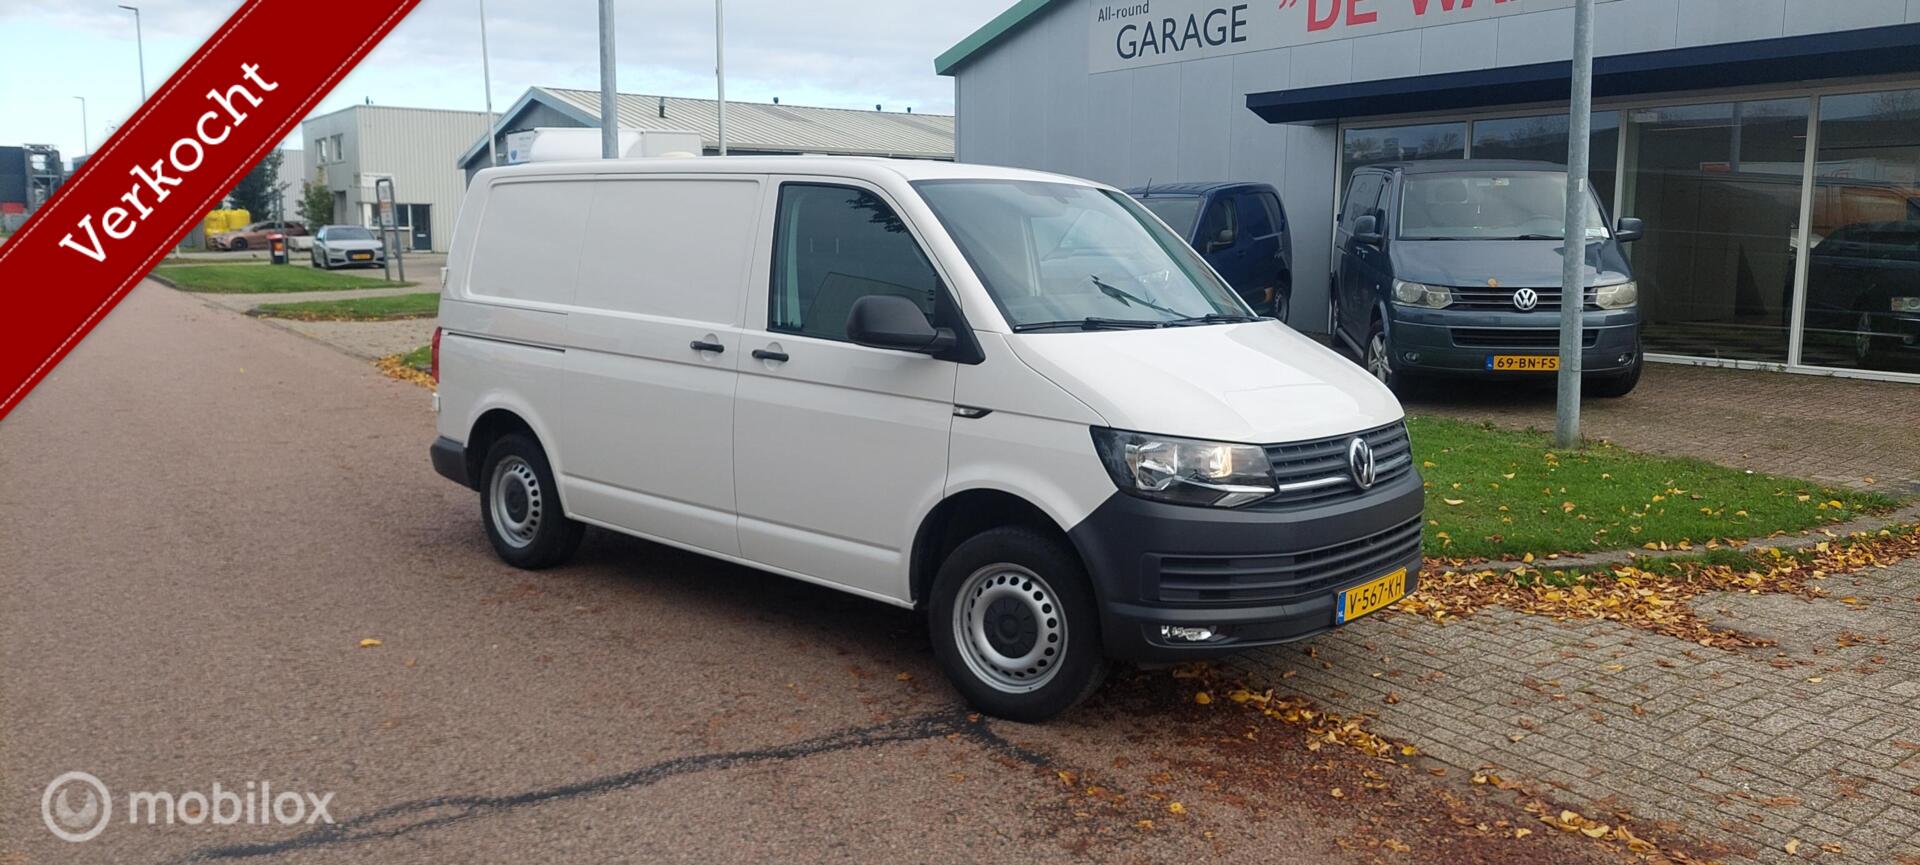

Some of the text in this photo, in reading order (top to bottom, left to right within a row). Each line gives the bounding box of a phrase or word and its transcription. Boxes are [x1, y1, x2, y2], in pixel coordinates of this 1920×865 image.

[1098, 1, 1149, 22] All-round
[1116, 4, 1248, 60] GARAGE
[1497, 357, 1556, 369] 69-BN-FS
[1349, 574, 1402, 615] V-567-KH
